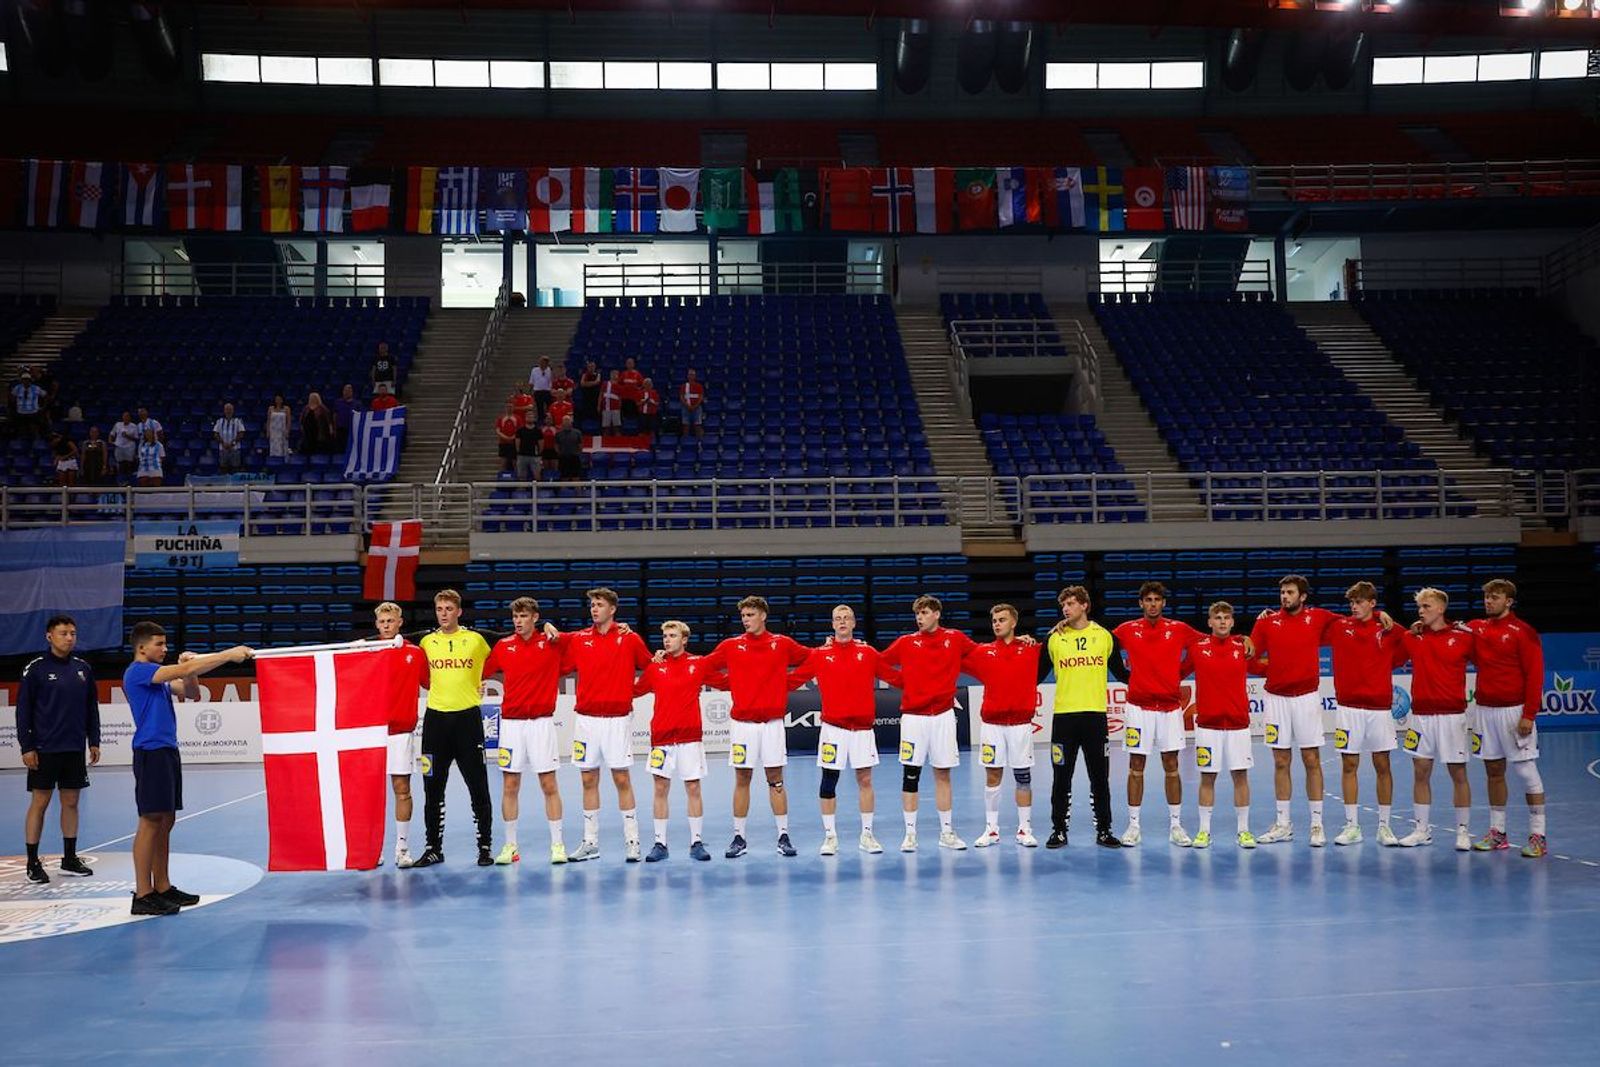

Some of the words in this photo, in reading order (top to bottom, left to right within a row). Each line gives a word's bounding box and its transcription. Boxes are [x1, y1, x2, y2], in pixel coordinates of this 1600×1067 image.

[177, 525, 199, 536] LA
[155, 536, 223, 551] PUCHIÑA
[449, 640, 454, 653] 1
[1075, 637, 1087, 651] 12
[429, 658, 474, 669] NORLYS
[1059, 656, 1104, 669] NORLYS
